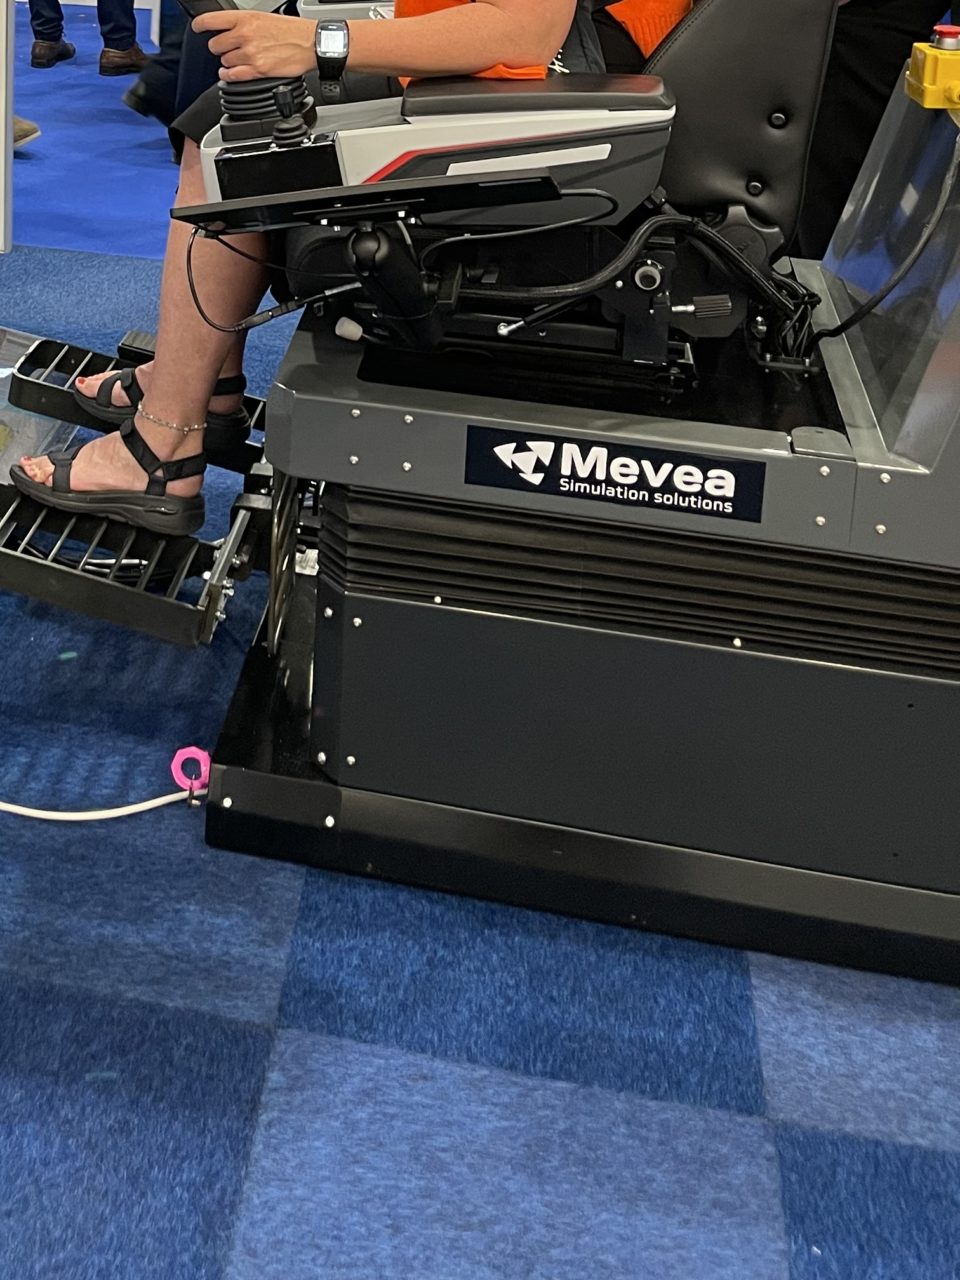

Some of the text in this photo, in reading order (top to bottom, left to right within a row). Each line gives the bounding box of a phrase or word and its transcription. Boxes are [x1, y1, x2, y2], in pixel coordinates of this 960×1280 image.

[559, 442, 736, 498] Mevea
[559, 477, 734, 513] Simulation solutions
